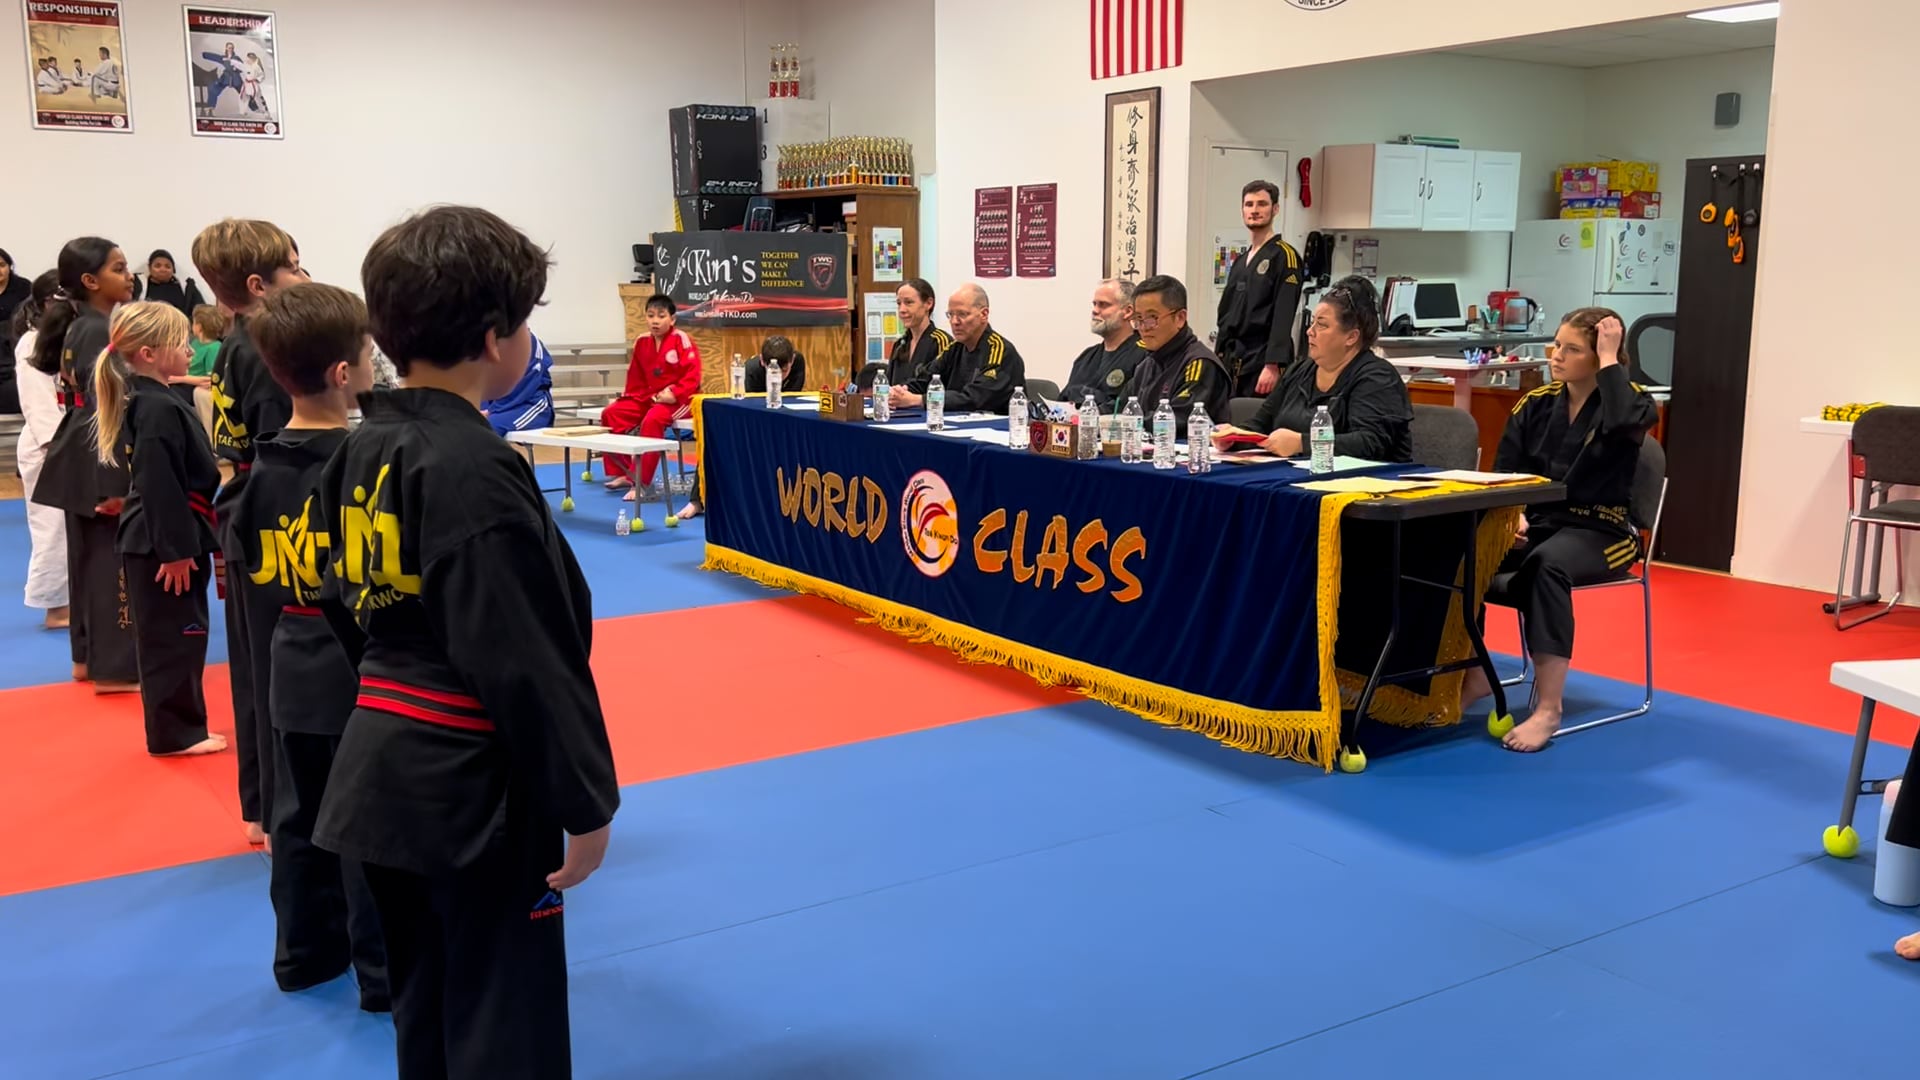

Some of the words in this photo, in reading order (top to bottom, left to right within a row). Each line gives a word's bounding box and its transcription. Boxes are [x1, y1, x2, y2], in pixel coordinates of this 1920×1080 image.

[29, 2, 117, 17] RESPONSIBILITY
[198, 15, 263, 28] LEADERSHIP
[761, 251, 800, 259] TOGETHER
[773, 261, 789, 269] CAN
[761, 280, 805, 288] DIFFERENCE
[777, 464, 888, 544] WORLD
[973, 508, 1147, 603] CLASS
